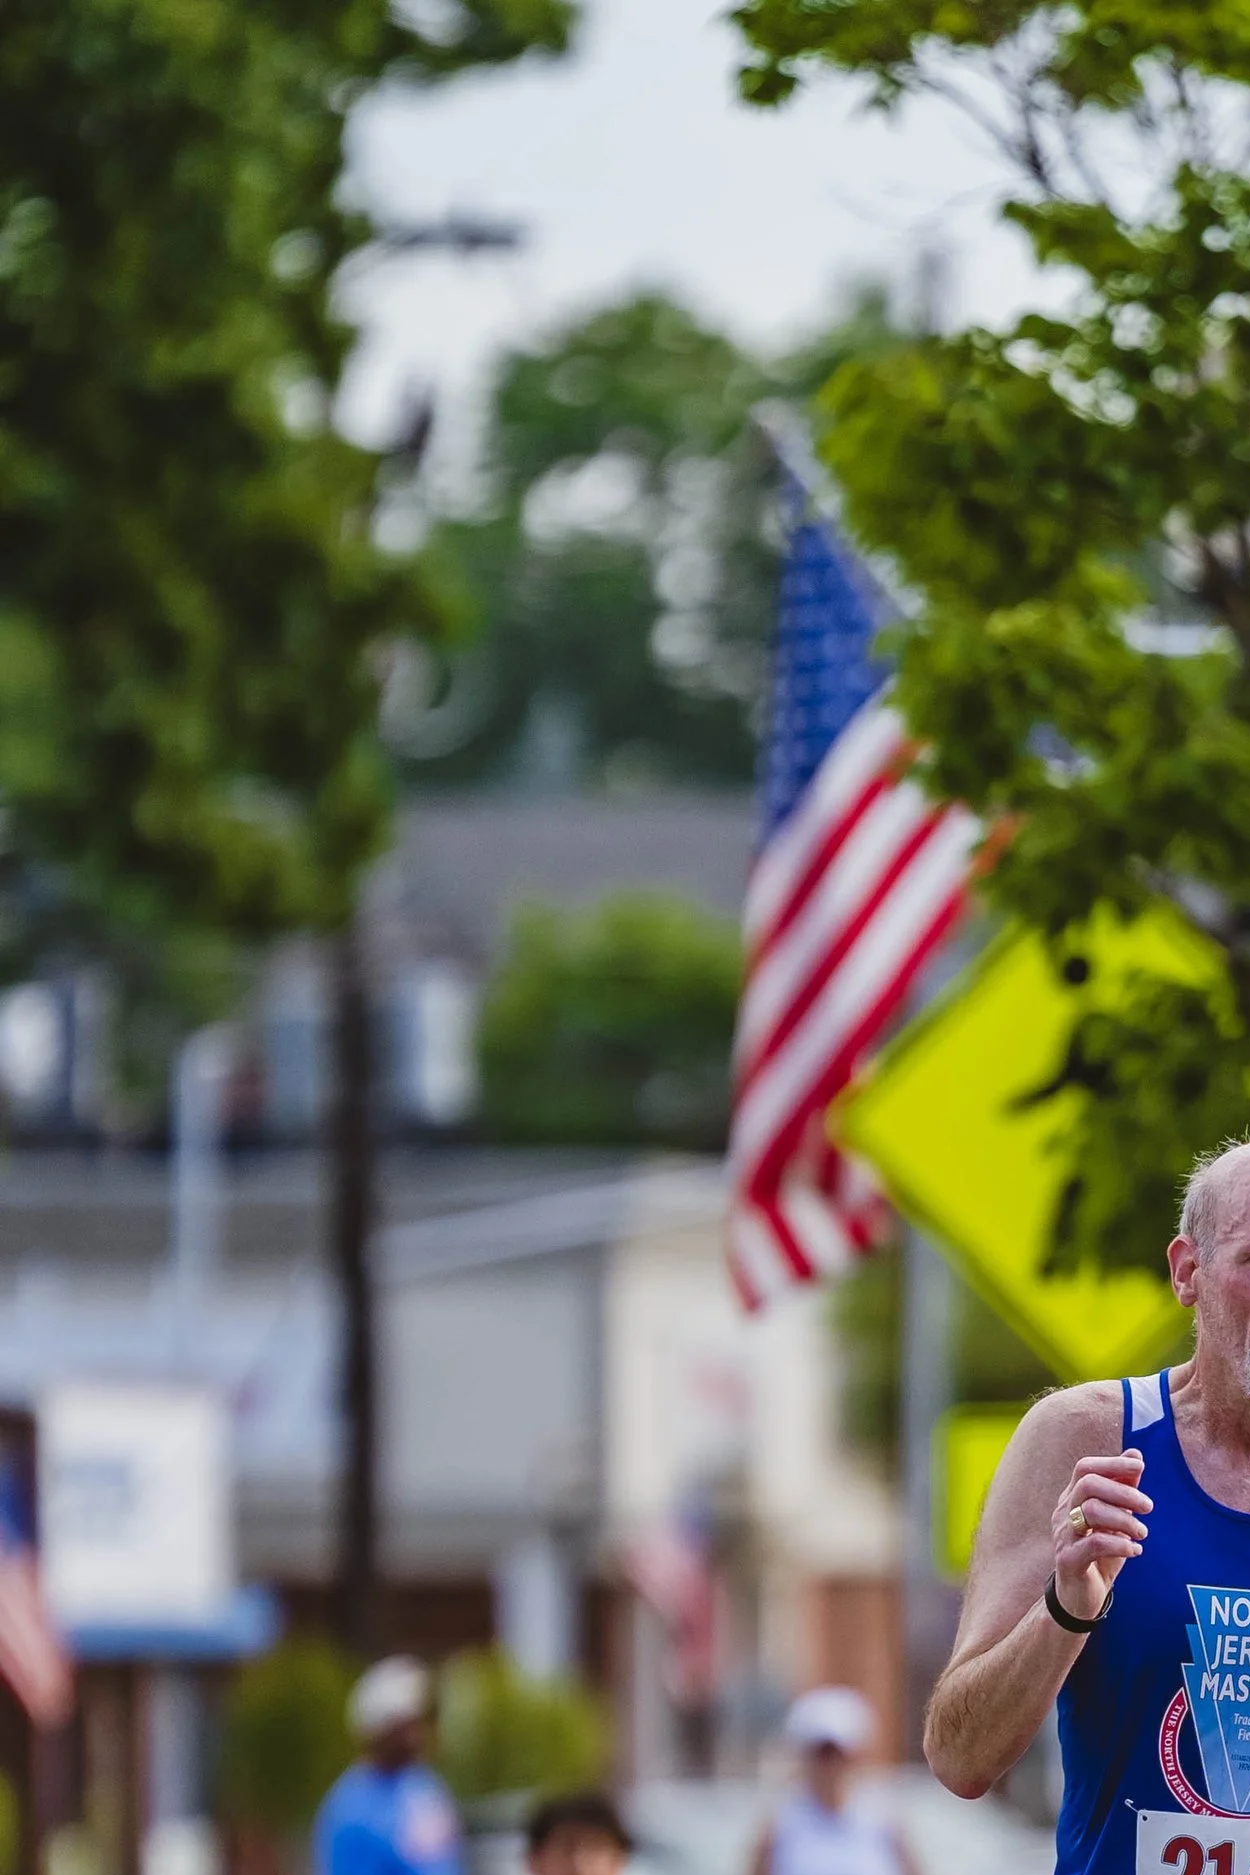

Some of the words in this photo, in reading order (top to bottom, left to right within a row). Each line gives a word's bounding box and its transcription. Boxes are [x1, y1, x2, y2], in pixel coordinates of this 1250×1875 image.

[1167, 1705, 1184, 1727] THE
[1164, 1730, 1175, 1772] NORTH
[1168, 1774, 1201, 1809] JERSEY
